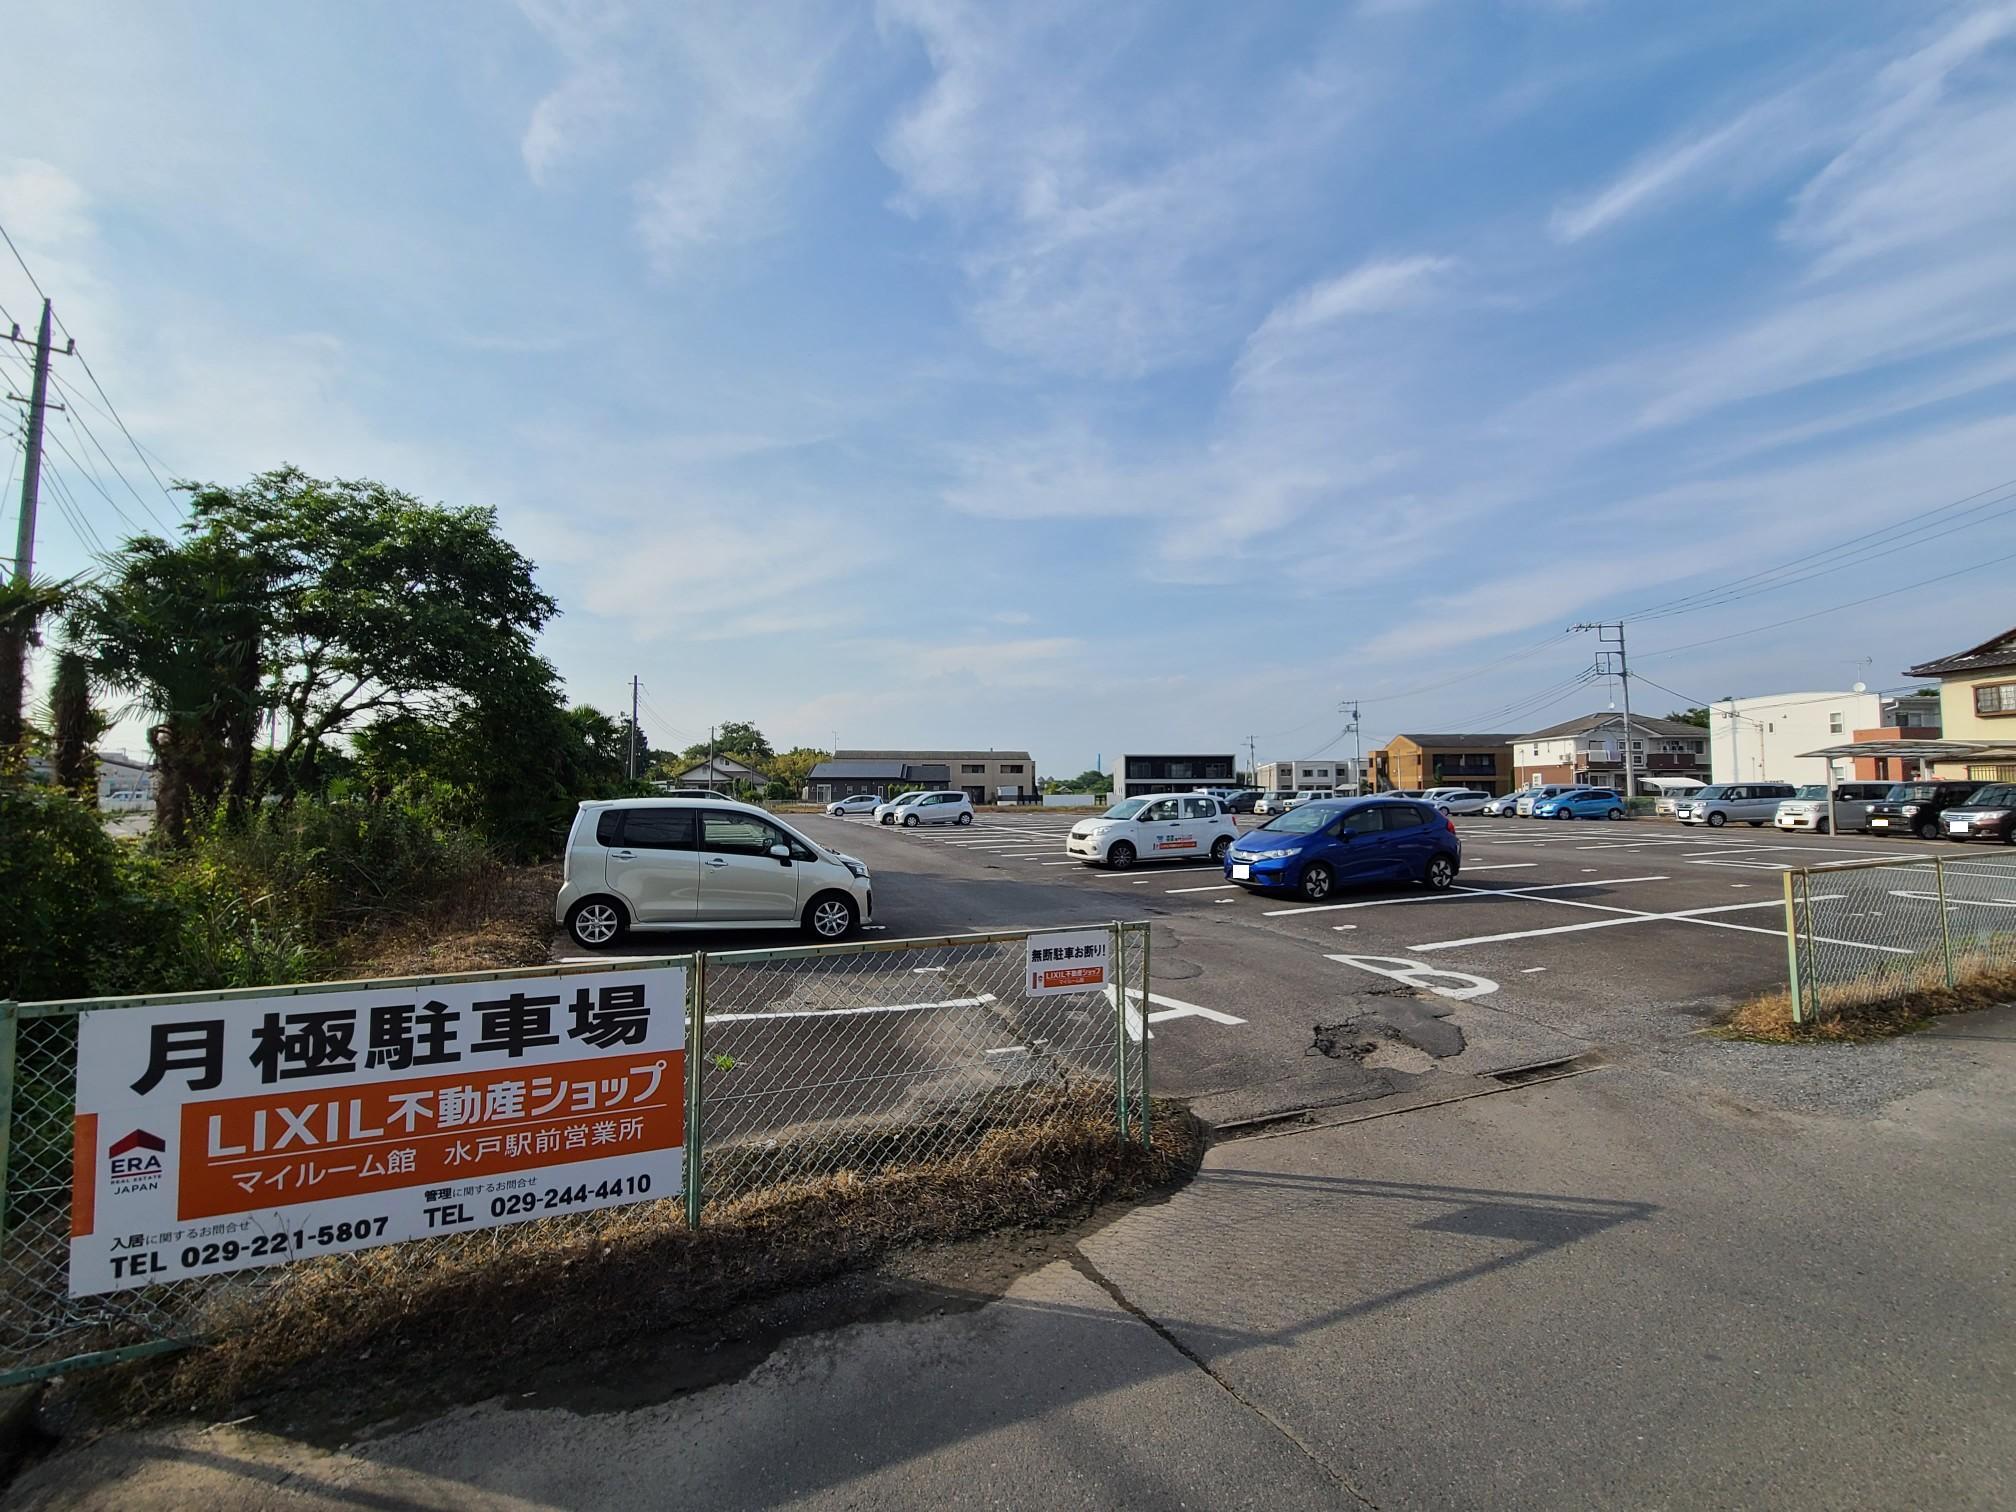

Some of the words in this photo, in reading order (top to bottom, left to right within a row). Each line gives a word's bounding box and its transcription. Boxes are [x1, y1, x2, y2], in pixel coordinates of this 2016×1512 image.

[1031, 944, 1106, 963] 無断駐車お断り!
[129, 984, 651, 1097] 月極駐車場
[207, 1060, 668, 1158] LIXIL不動産ショップ
[111, 1155, 162, 1174] ERA
[232, 1148, 416, 1195] マイルーム館
[444, 1116, 645, 1167] 水戸駅前営業所
[114, 1182, 158, 1195] JAPAN
[423, 1203, 475, 1229] TEL
[490, 1174, 652, 1218] 029-244-4410
[424, 1176, 538, 1203] 管理に関するお問合せ
[110, 1220, 251, 1252] 入居に関するお問合せ
[110, 1252, 168, 1279] TEL
[181, 1216, 389, 1268] 029-221-5807
